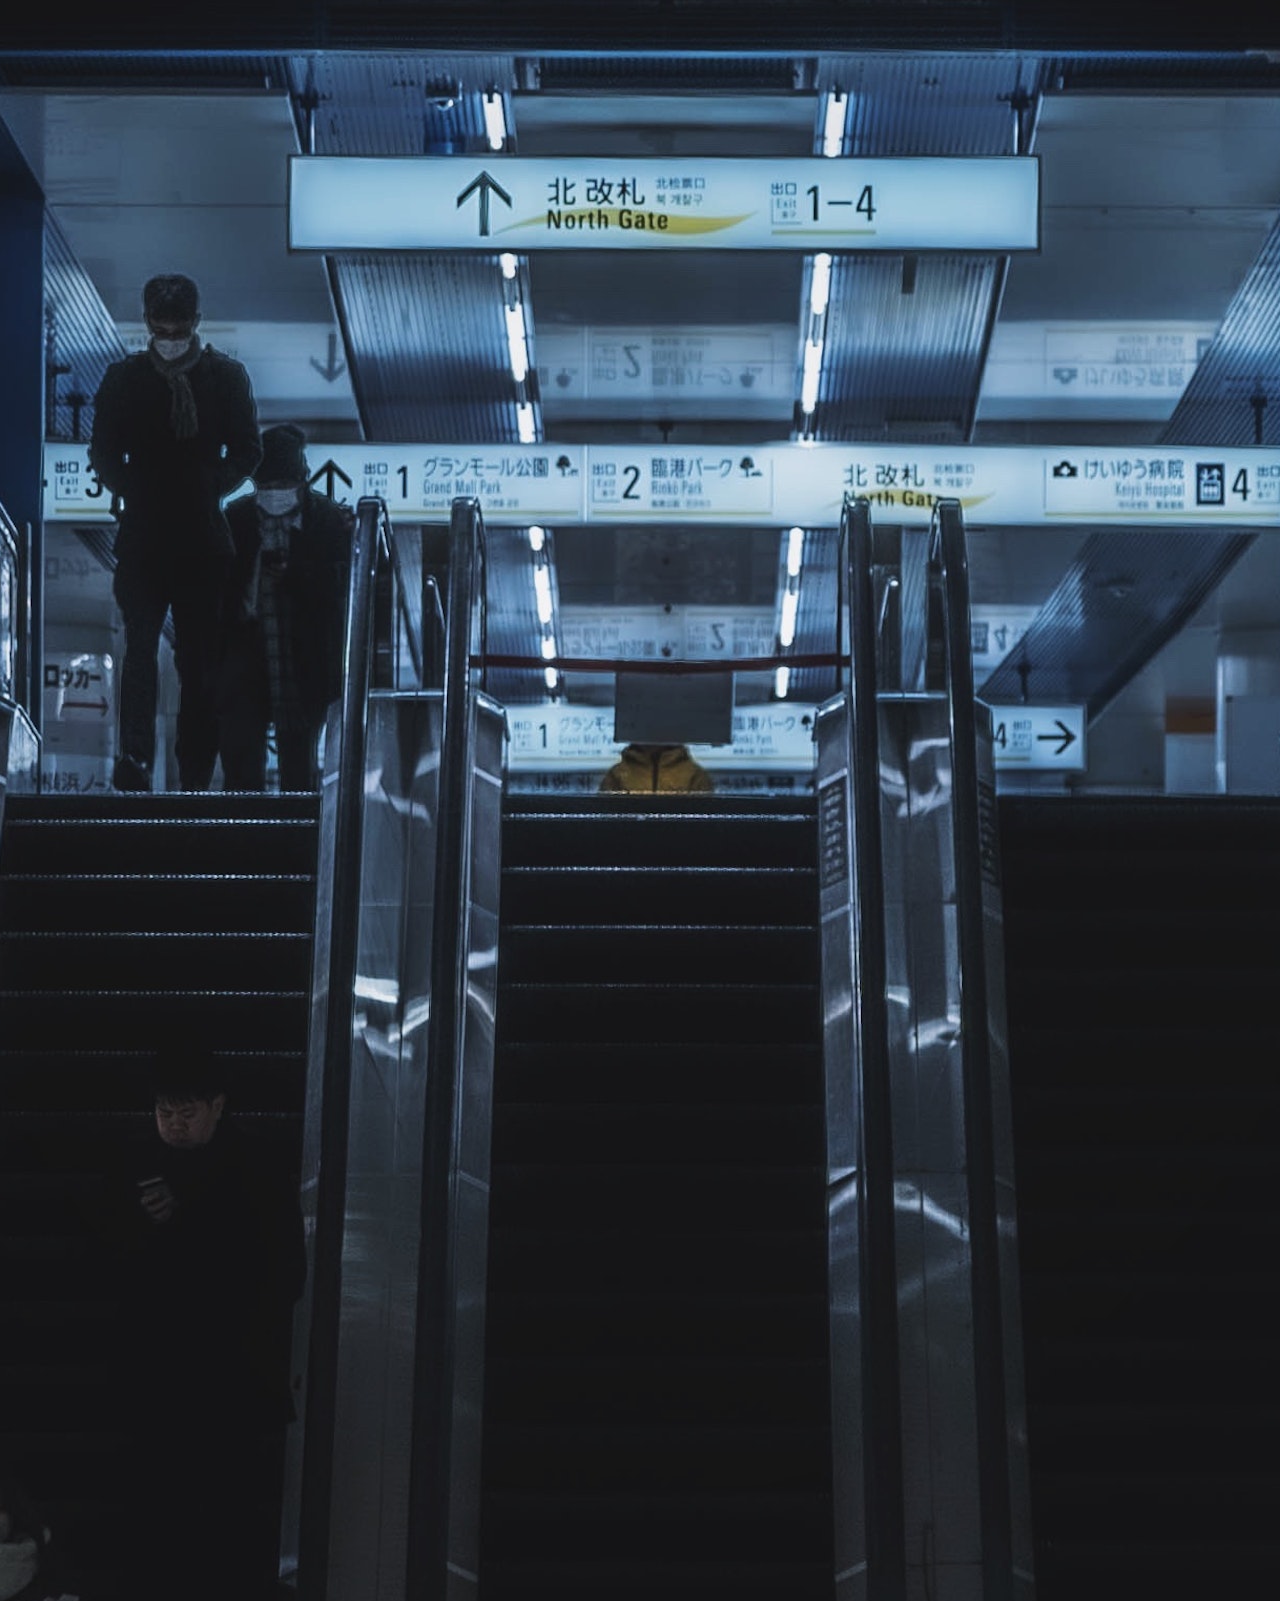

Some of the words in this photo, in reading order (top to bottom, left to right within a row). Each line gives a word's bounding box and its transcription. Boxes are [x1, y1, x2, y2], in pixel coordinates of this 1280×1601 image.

[771, 182, 797, 196] 出口
[547, 209, 609, 229] North
[619, 209, 669, 230] Gate
[55, 461, 79, 474] 出口
[363, 463, 389, 475] 出口
[423, 457, 550, 478] グランモール公園
[592, 463, 617, 476] 出口
[1083, 459, 1186, 480] けいゆう病院
[1257, 466, 1280, 478] 出口
[85, 462, 104, 498] 3
[396, 466, 408, 498] 1
[423, 479, 452, 495] Grand
[480, 479, 502, 495] Park
[623, 465, 641, 499] 2
[682, 479, 703, 495] Park
[1145, 481, 1186, 498] Hospital
[1231, 468, 1251, 502] 4
[44, 665, 102, 689] ロッカー
[538, 723, 548, 749] 1
[994, 722, 1007, 749] 4
